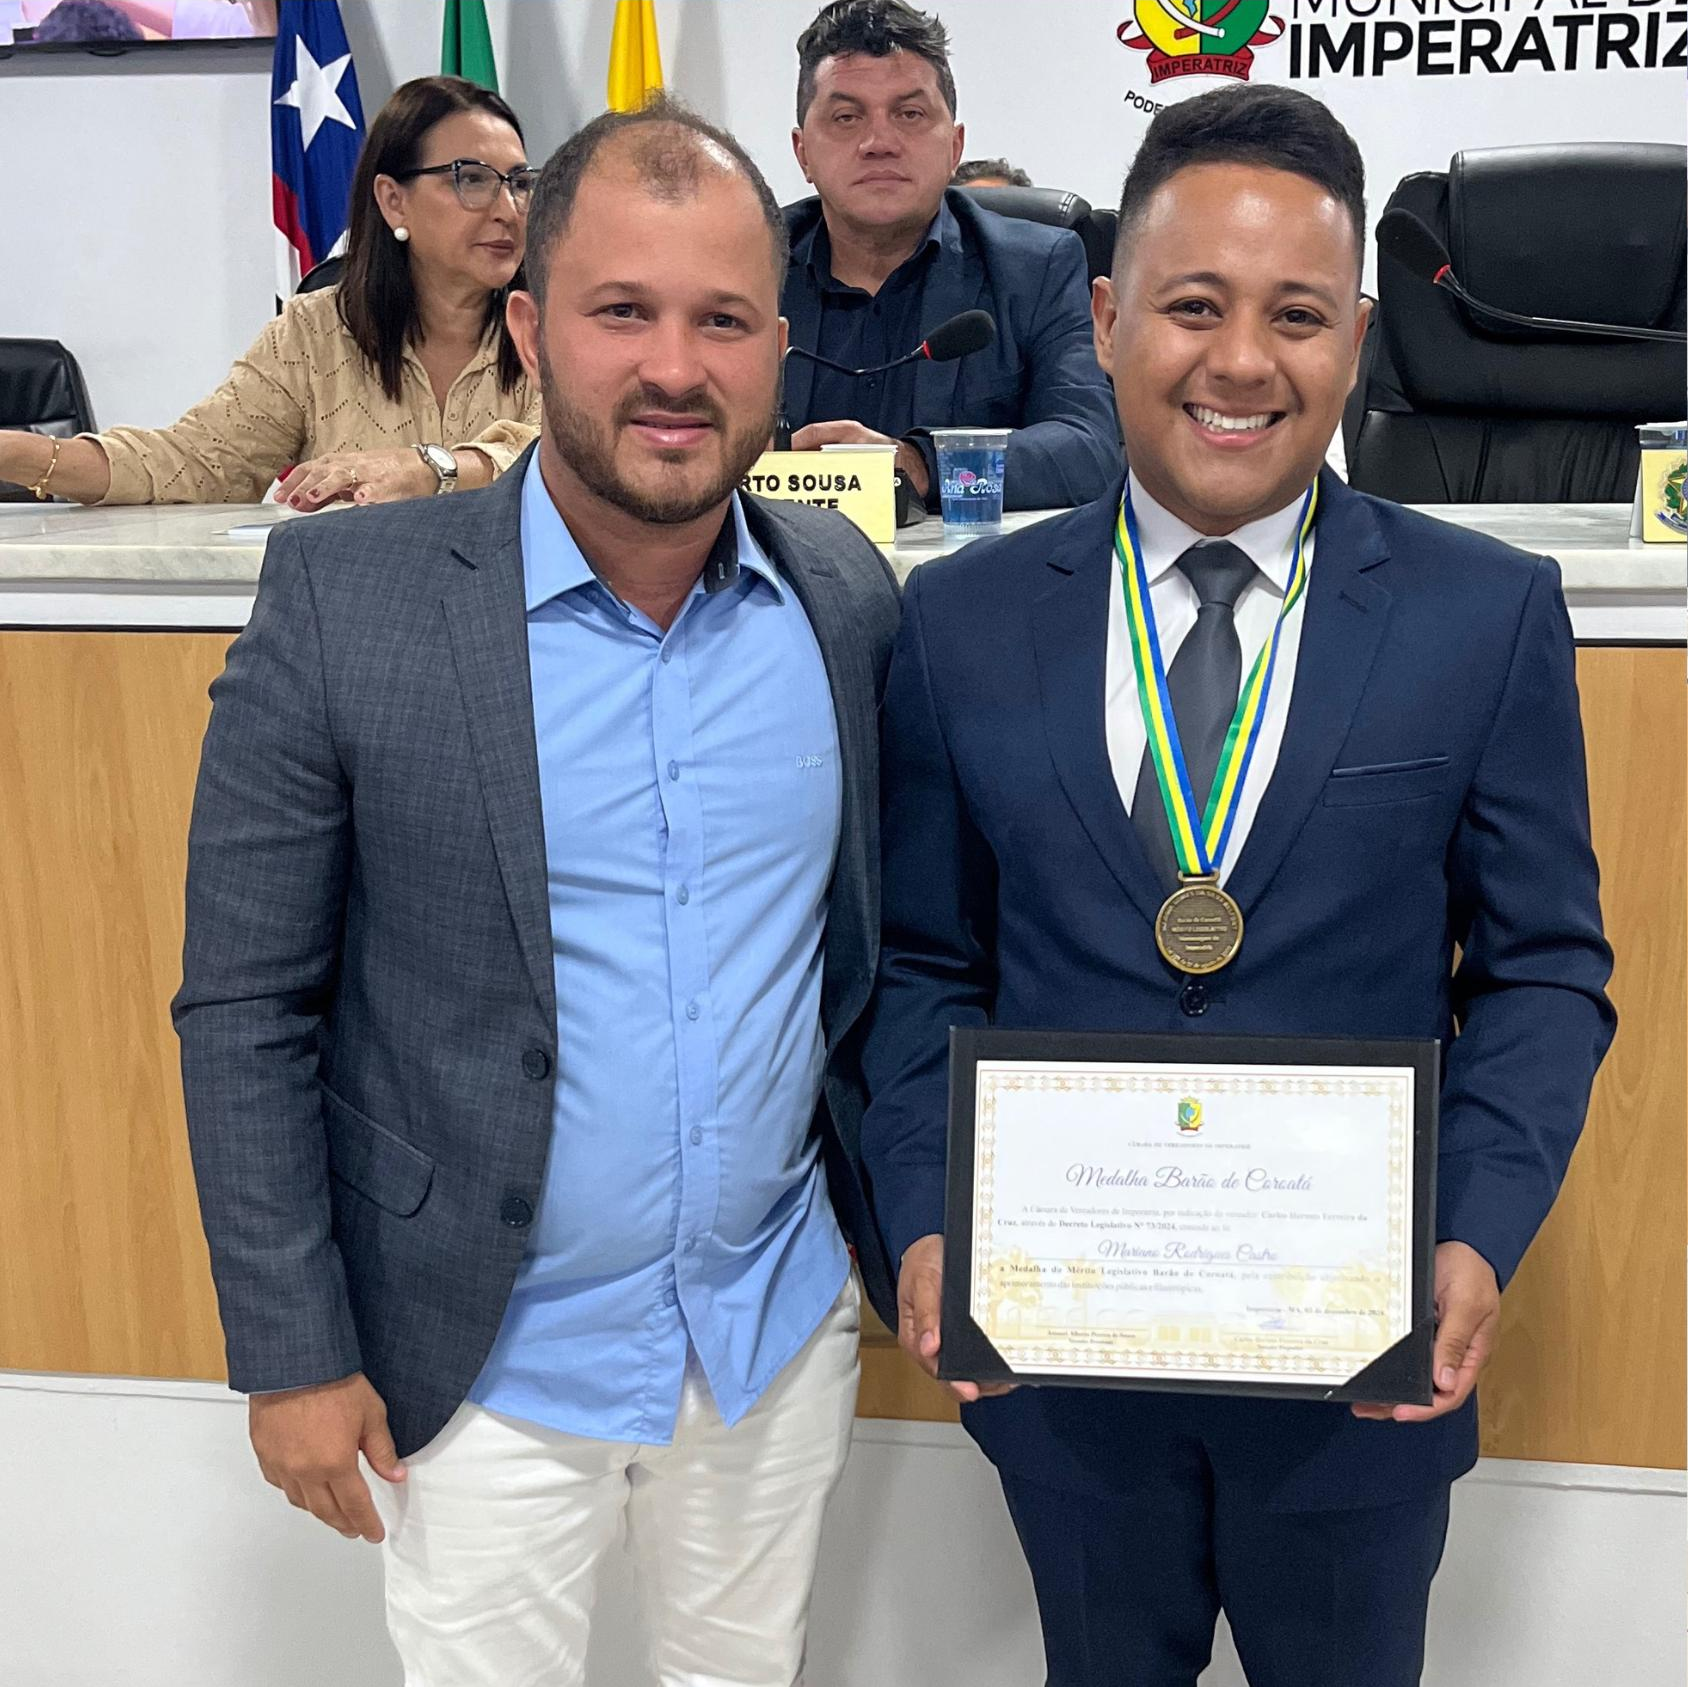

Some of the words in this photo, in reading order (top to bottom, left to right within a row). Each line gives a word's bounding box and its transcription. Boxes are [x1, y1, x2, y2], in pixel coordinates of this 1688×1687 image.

[1154, 57, 1247, 78] IMPERATRIZ
[1124, 90, 1164, 114] PODE
[740, 475, 780, 492] RTO
[788, 475, 861, 491] SOUSA
[1065, 1163, 1149, 1190] Medalha
[1153, 1166, 1216, 1189] Barão
[1221, 1172, 1239, 1189] de
[1245, 1168, 1313, 1192] Coroatá
